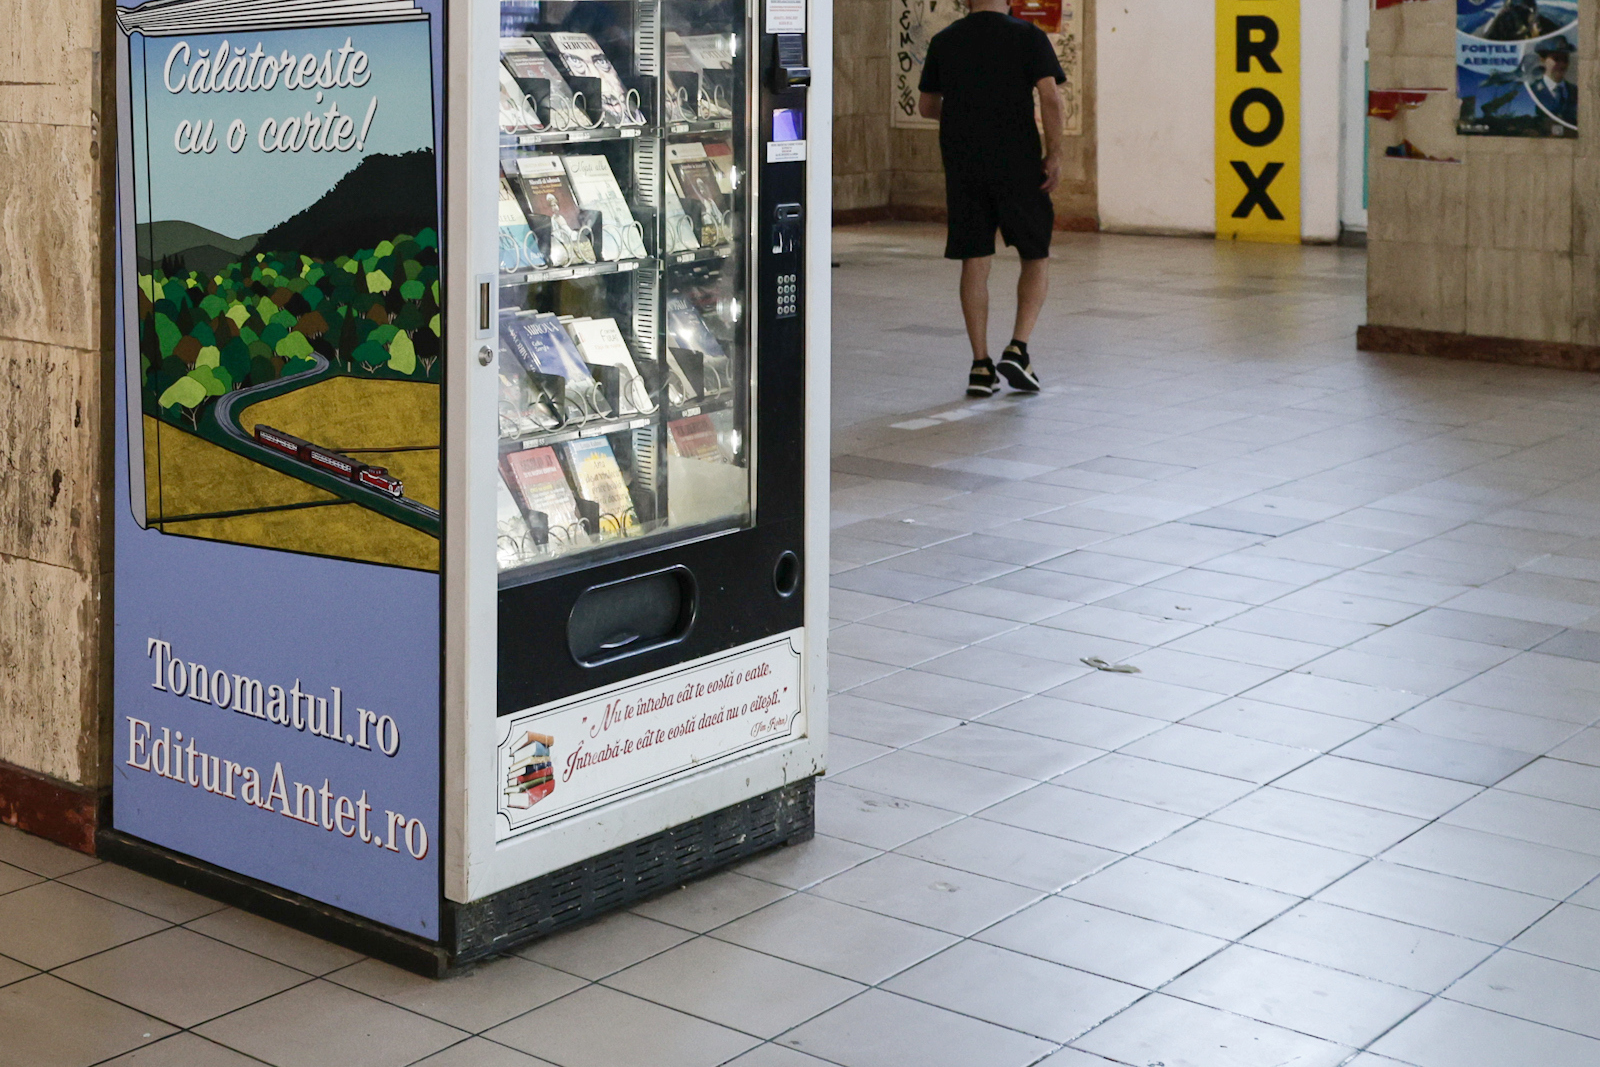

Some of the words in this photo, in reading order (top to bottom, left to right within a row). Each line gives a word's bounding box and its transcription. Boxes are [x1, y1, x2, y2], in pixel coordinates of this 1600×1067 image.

[164, 37, 371, 103] Călătorește
[1464, 57, 1518, 65] AERIENE
[174, 119, 217, 153] cu
[226, 119, 247, 153] o
[258, 96, 377, 153] carte!
[148, 637, 400, 757] Tonomatul.ro
[590, 699, 622, 738] Nu
[624, 706, 634, 721] te
[636, 694, 674, 716] întreba
[677, 683, 693, 705] cât
[695, 683, 705, 699] te
[707, 671, 735, 694] costă
[736, 673, 742, 684] o
[745, 663, 772, 682] carte.
[562, 739, 634, 783] Întreabă-te
[636, 730, 654, 748] cât
[655, 729, 665, 744] te
[667, 716, 696, 738] costă
[698, 708, 725, 729] dacă
[727, 706, 739, 720] nu
[742, 704, 748, 715] o
[126, 716, 428, 860] EdituraAntet.ro
